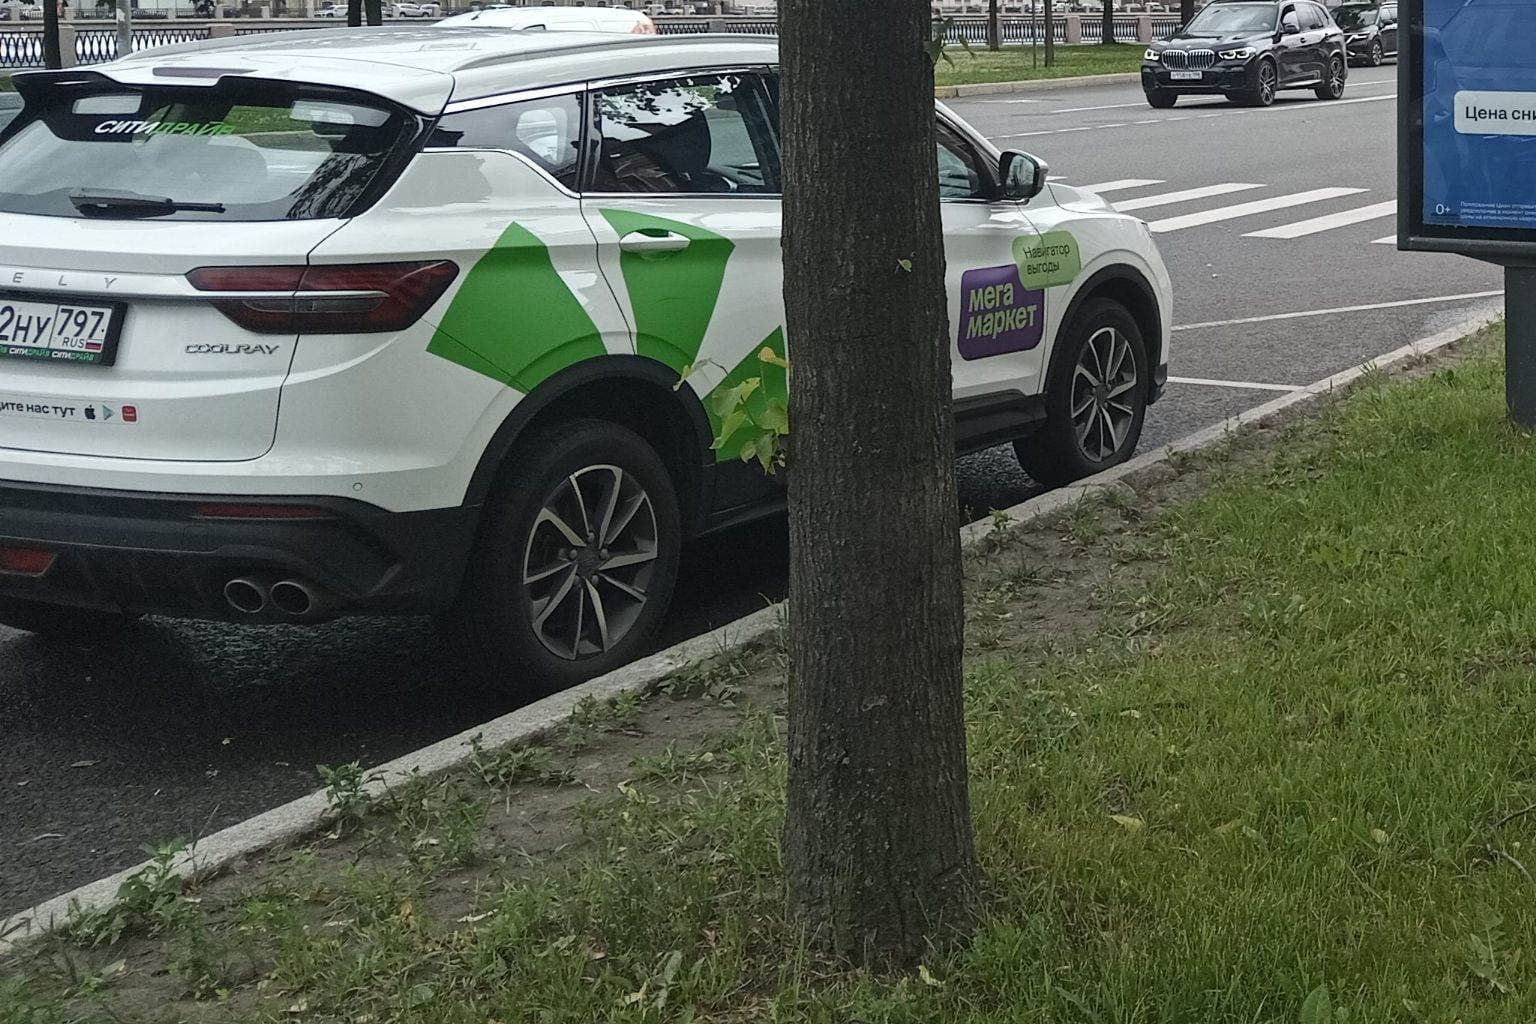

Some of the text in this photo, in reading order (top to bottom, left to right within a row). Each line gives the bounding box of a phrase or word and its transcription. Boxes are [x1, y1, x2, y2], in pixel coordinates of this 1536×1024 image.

[1465, 105, 1508, 122] Цена
[1023, 243, 1071, 260] Навигатор
[1026, 260, 1061, 275] выгоды
[968, 282, 1014, 313] мега
[57, 308, 104, 339] 797
[966, 304, 1038, 340] маркет
[62, 336, 85, 349] RUS
[0, 401, 76, 418] ите нас тут
